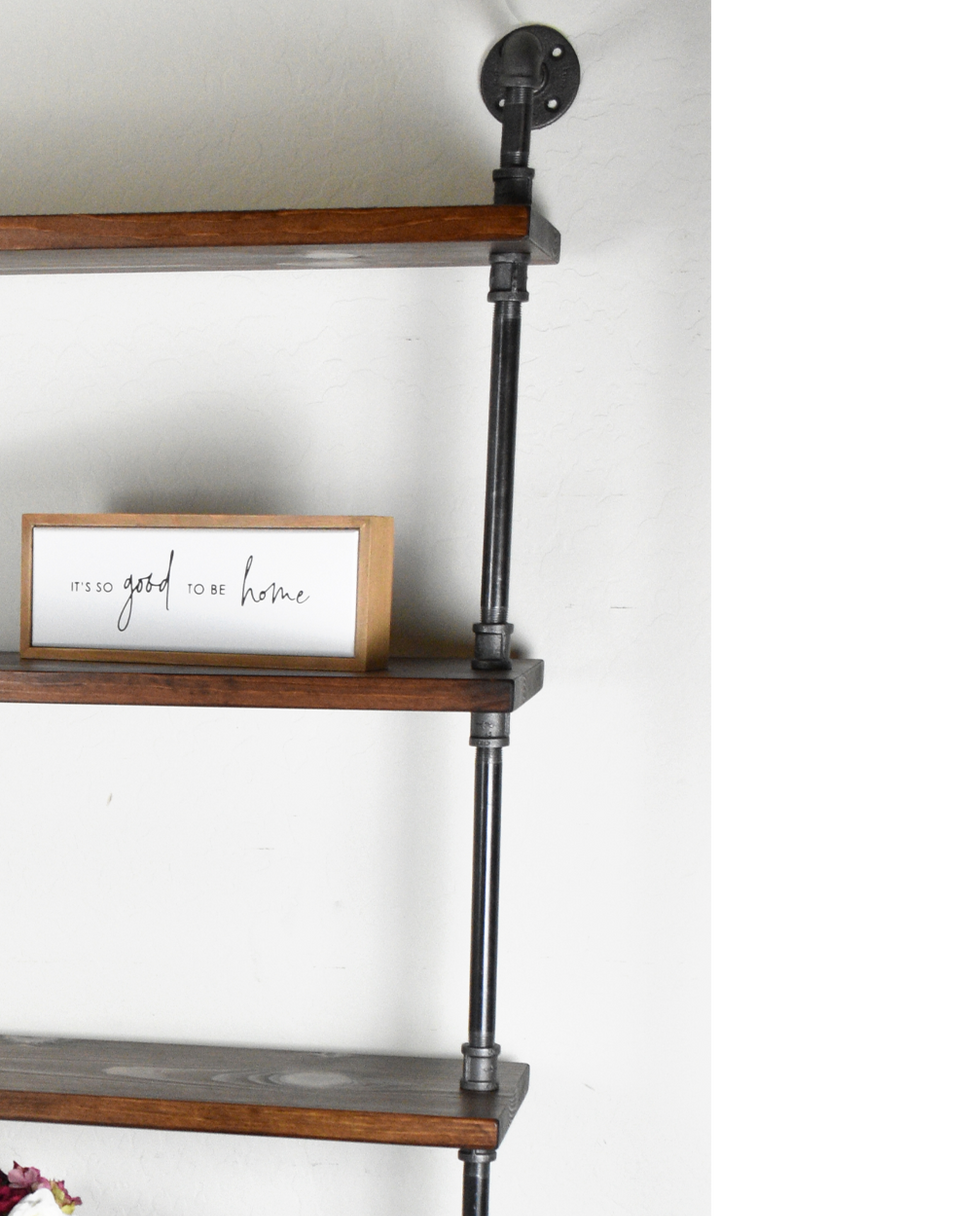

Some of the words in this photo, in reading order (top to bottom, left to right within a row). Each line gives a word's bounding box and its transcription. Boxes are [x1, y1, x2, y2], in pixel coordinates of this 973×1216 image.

[70, 581, 92, 593] IT'S
[96, 582, 114, 593] SO
[117, 550, 175, 632] good
[187, 583, 206, 595] TO
[210, 584, 226, 596] BE
[241, 555, 310, 607] home
